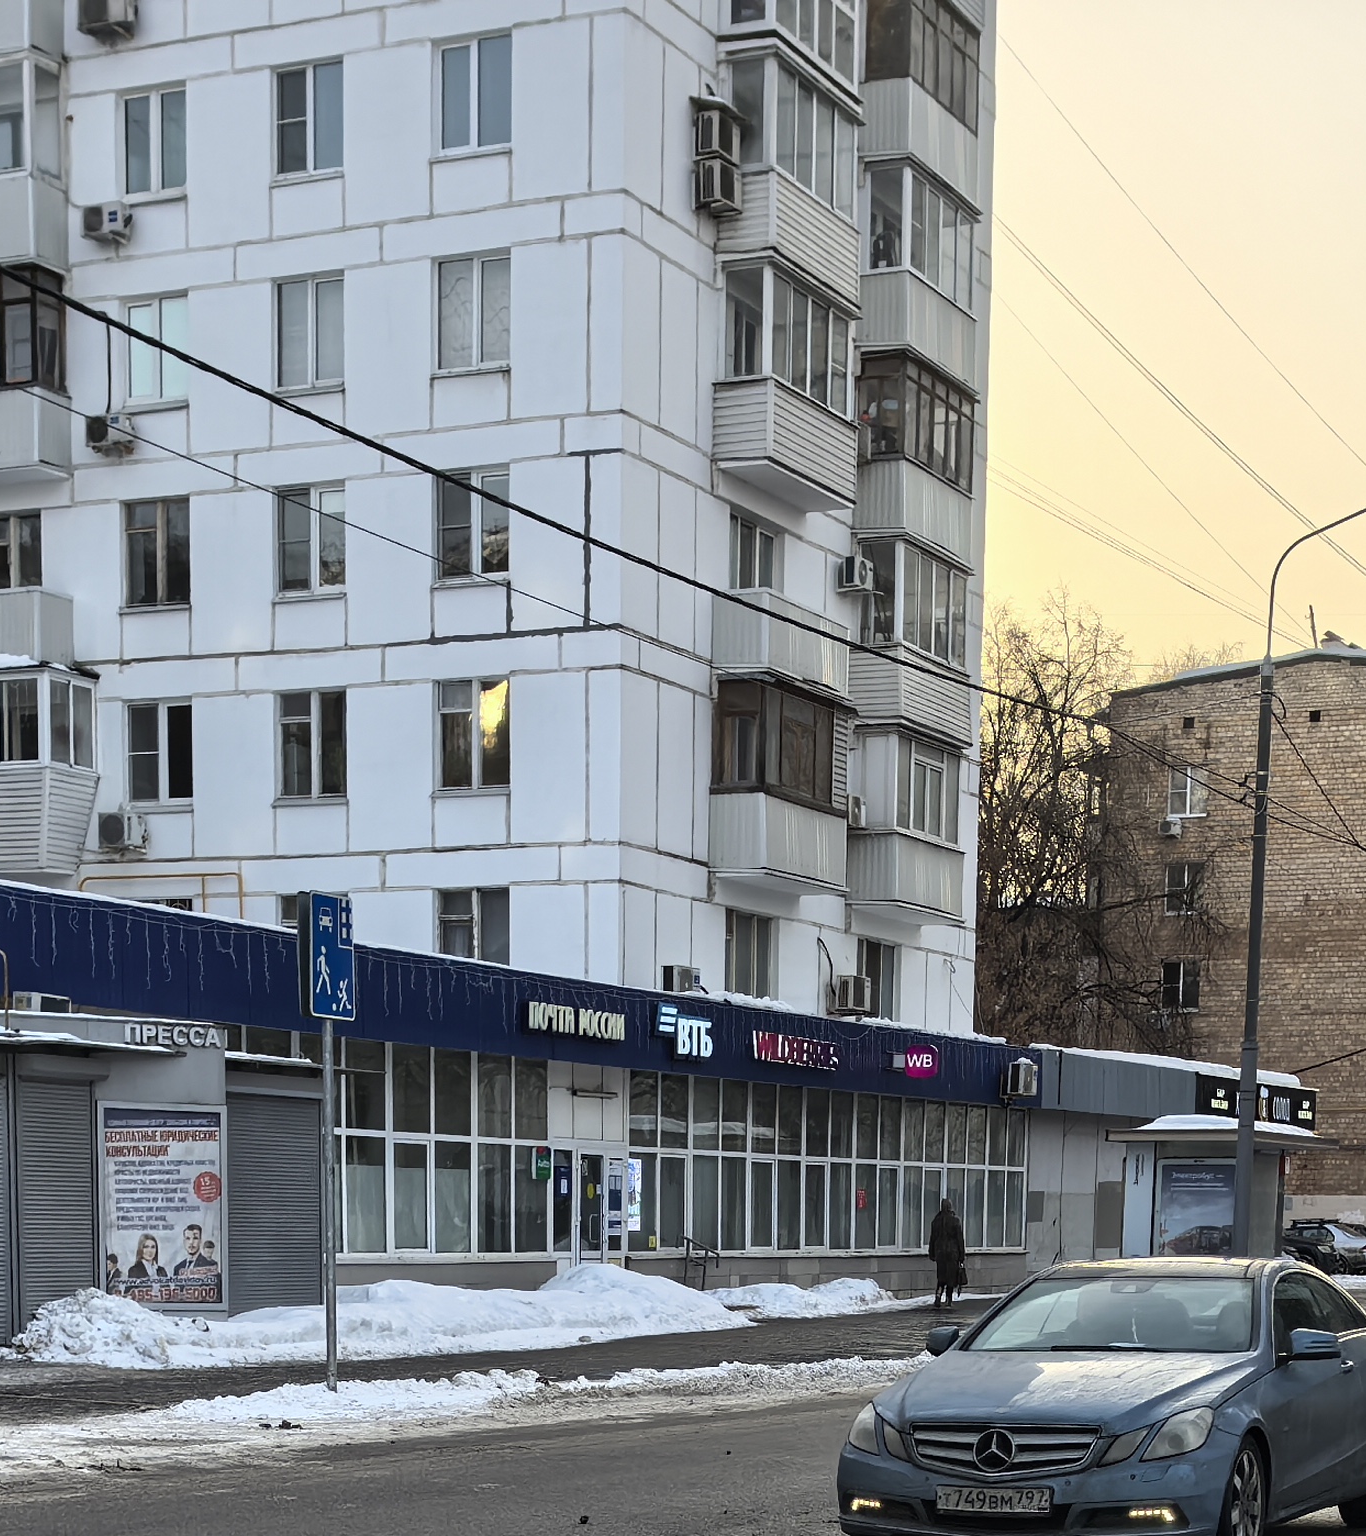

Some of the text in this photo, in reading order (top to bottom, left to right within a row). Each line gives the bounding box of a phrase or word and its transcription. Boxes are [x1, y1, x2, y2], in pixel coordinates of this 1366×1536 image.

[528, 1001, 625, 1041] ПОЧТА РОССИИ
[124, 1022, 222, 1048] ПРЕССА
[677, 1018, 714, 1058] ВТБ
[906, 1053, 933, 1068] WB
[104, 1129, 219, 1143] БЕСПЛАТНЫЕ ЮРИДИЧЕСКИЕ
[105, 1144, 170, 1158] КОНСУЛЬТАЦИИ
